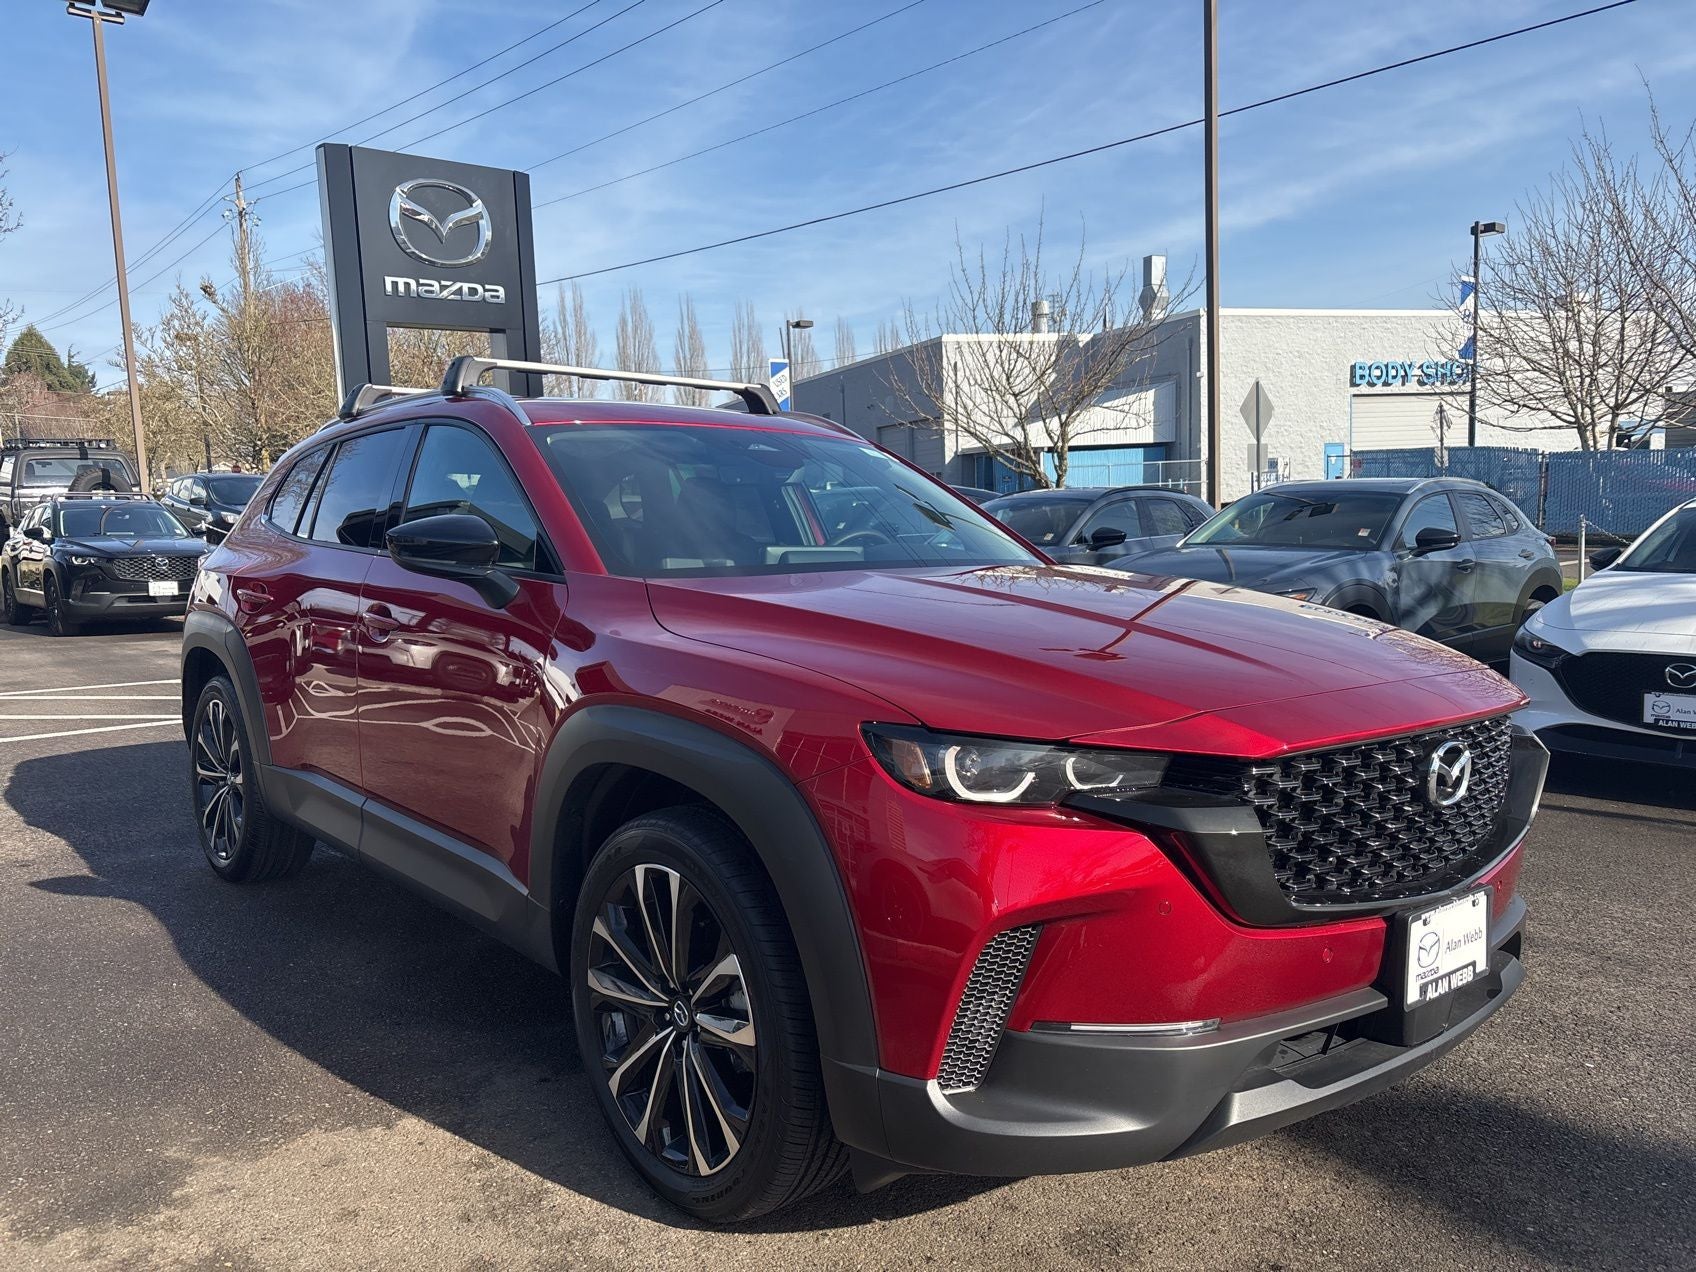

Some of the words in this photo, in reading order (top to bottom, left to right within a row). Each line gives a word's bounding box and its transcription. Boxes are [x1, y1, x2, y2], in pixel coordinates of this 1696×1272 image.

[1354, 360, 1416, 385] BODY
[1422, 360, 1475, 385] SHO
[1658, 719, 1679, 728] ALAN
[1445, 938, 1462, 954] Alan
[1463, 927, 1483, 946] Webb
[1426, 975, 1450, 1001] ALAN
[1450, 965, 1474, 990] WEBB
